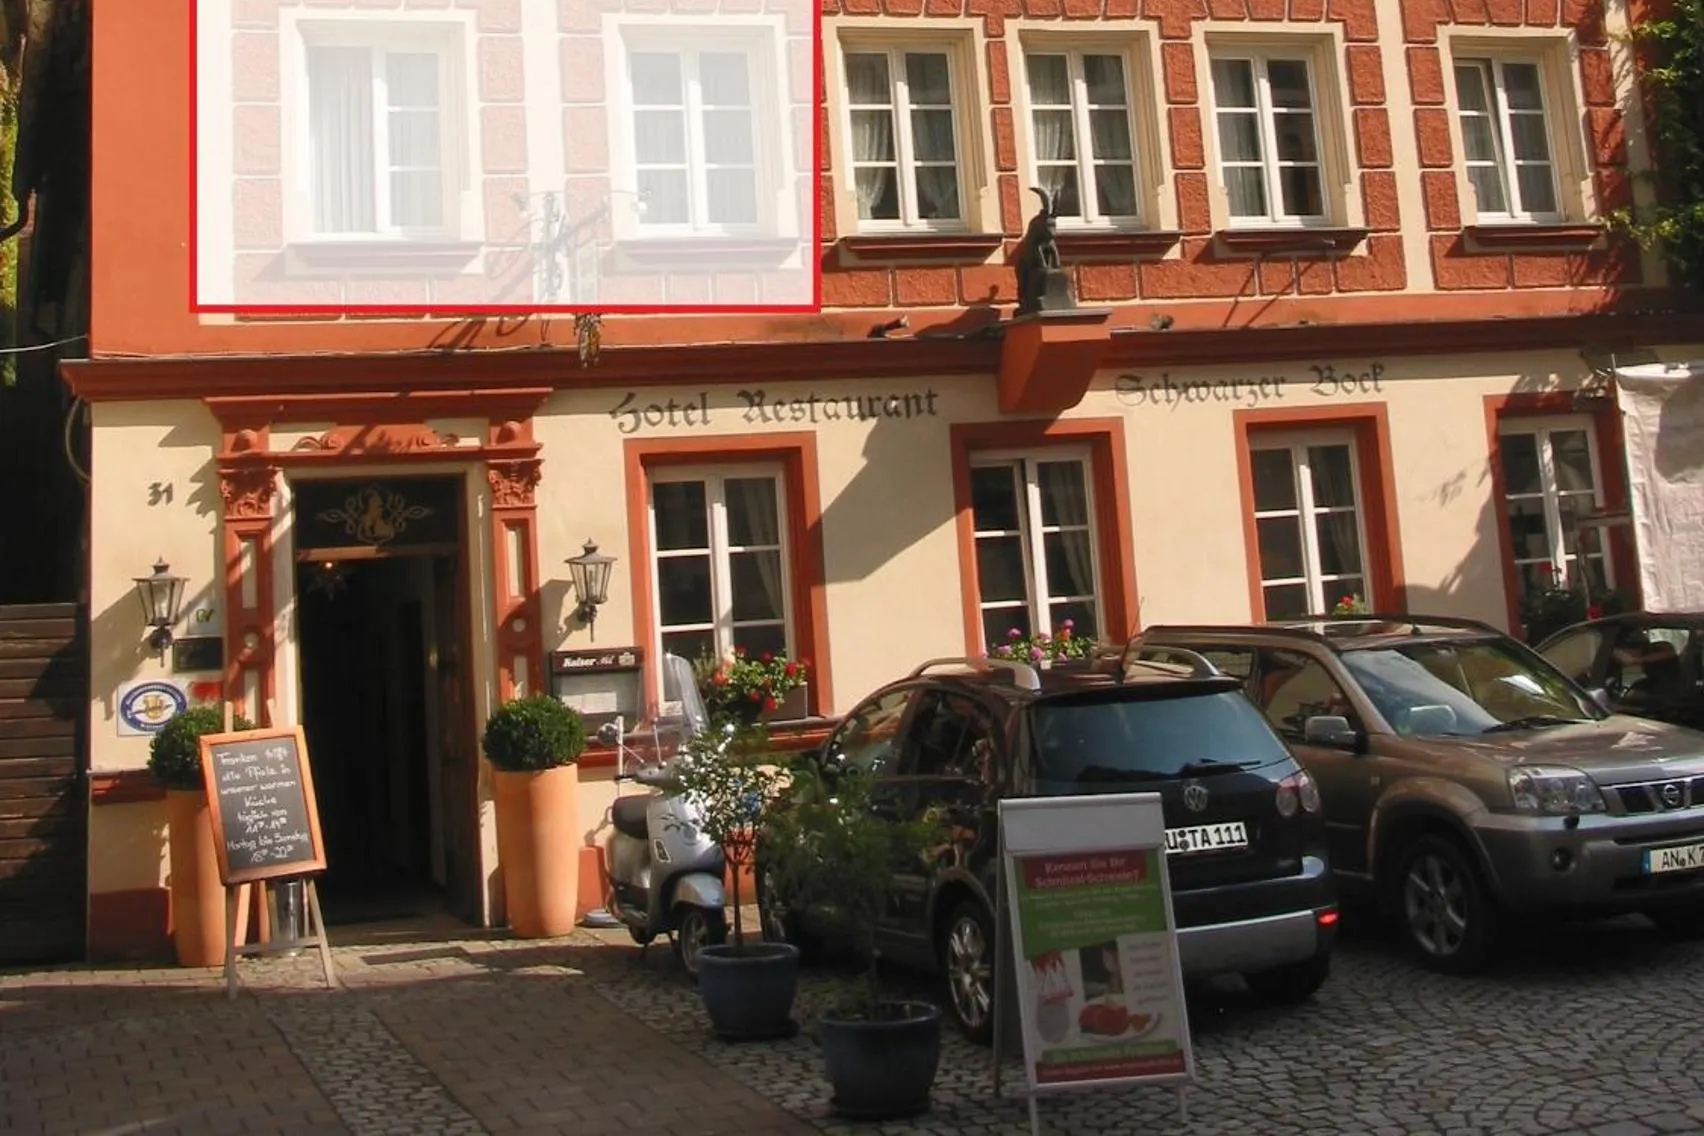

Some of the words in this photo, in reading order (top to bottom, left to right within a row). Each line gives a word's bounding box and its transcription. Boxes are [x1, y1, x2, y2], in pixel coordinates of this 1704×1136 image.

[609, 392, 711, 434] Hotel
[736, 387, 938, 425] Restaurant
[1114, 372, 1286, 412] Schwarzer
[1309, 362, 1385, 397] Bock
[280, 764, 292, 775] in
